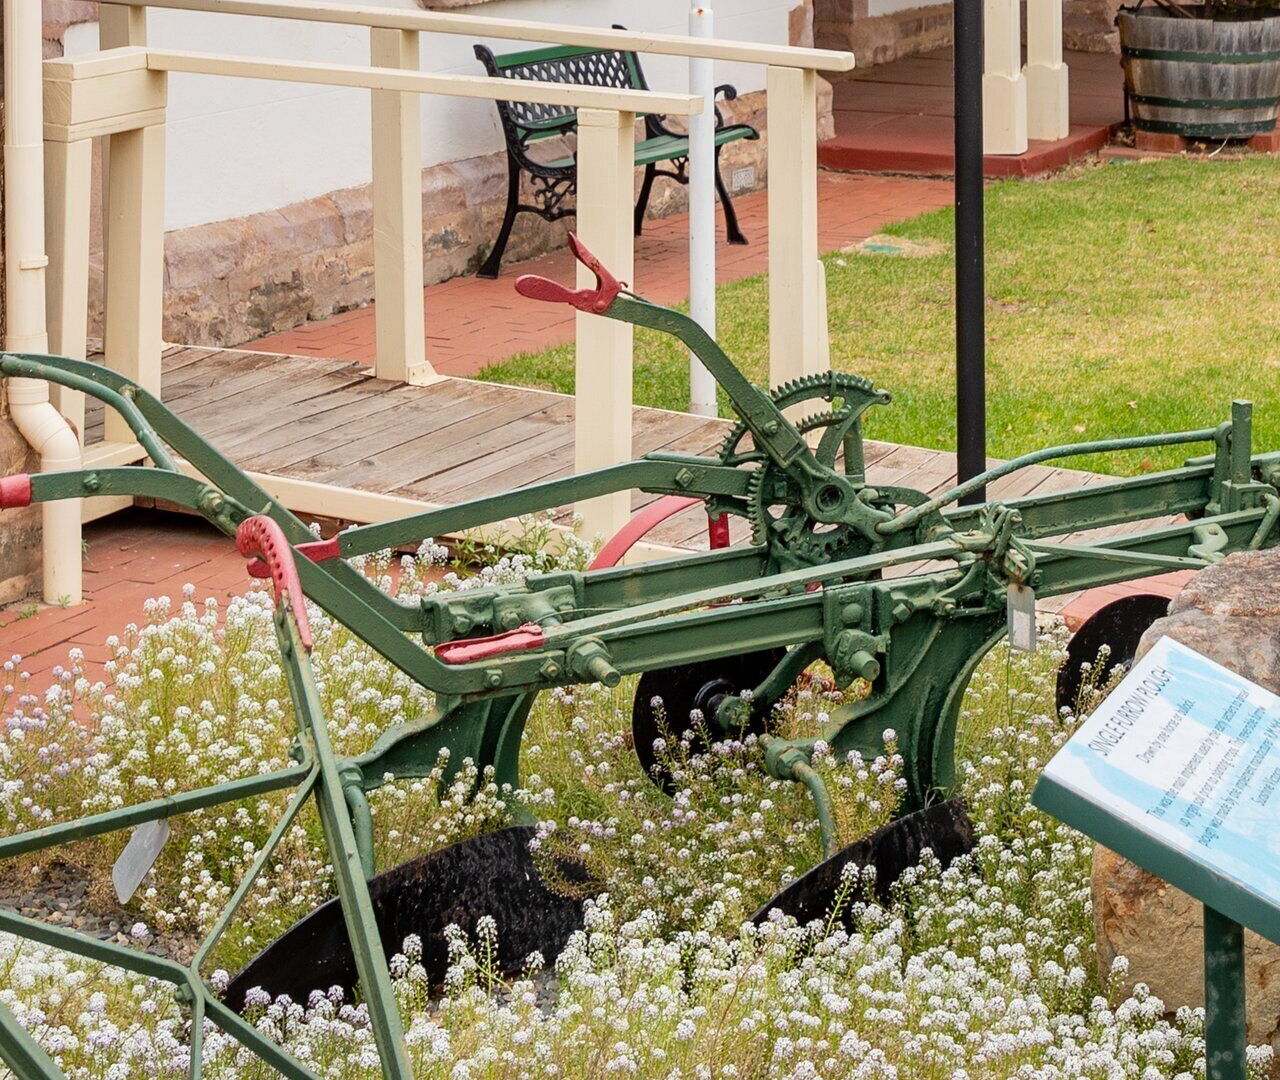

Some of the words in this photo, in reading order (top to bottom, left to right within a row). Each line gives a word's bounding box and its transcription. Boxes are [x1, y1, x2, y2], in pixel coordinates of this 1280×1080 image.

[1085, 721, 1127, 758] SINGLE
[1108, 690, 1152, 731] FURROW
[1133, 663, 1175, 700] PLOUGH
[1135, 742, 1160, 765] Drawn
[1158, 716, 1180, 734] horse
[1175, 750, 1207, 781] implement
